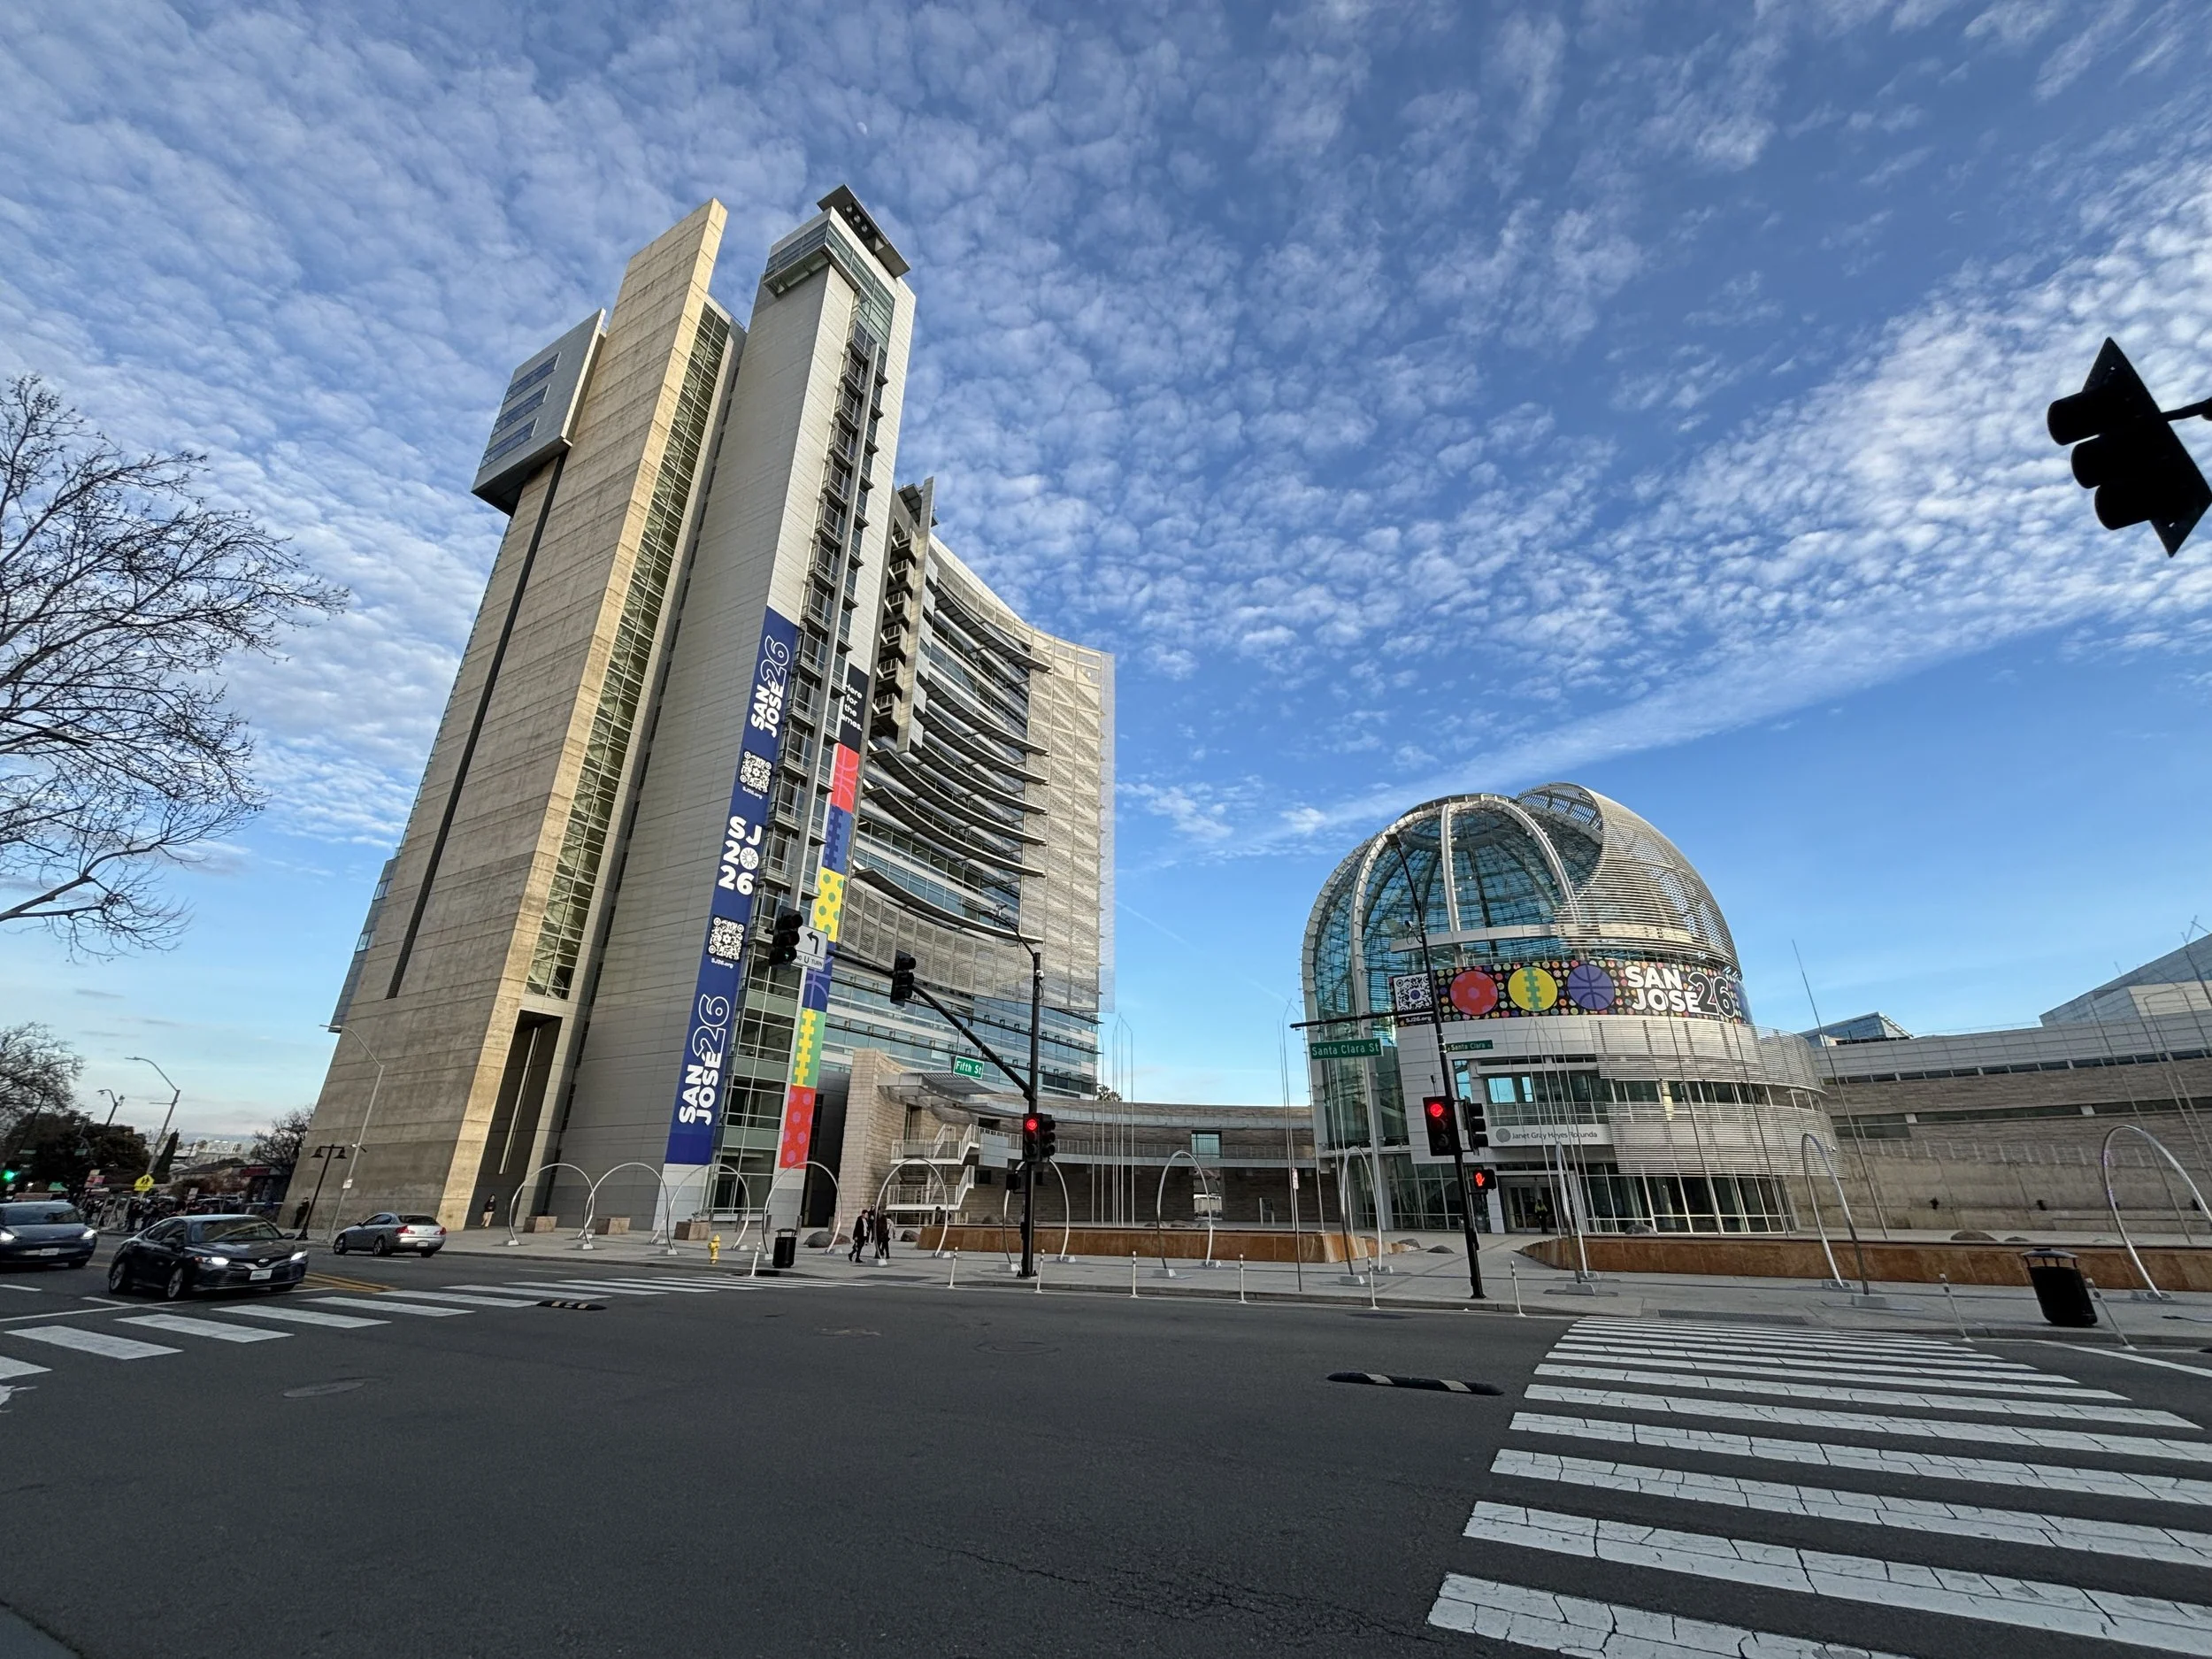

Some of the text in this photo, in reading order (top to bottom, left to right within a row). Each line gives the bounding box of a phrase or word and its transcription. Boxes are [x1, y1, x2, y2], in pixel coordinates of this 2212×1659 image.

[760, 634, 790, 738] JOSÉ 26
[847, 694, 858, 705] for
[750, 684, 771, 731] SAN
[844, 703, 857, 717] the
[727, 816, 763, 846] SJ
[718, 864, 755, 895] 26
[1624, 965, 1684, 991] SAN
[1632, 972, 1734, 1018] JOSÉ 26
[692, 994, 730, 1126] JOSÉ 26
[1311, 1042, 1379, 1056] Santa Clara St
[956, 1061, 982, 1074] Fifth St
[679, 1064, 704, 1125] SAN
